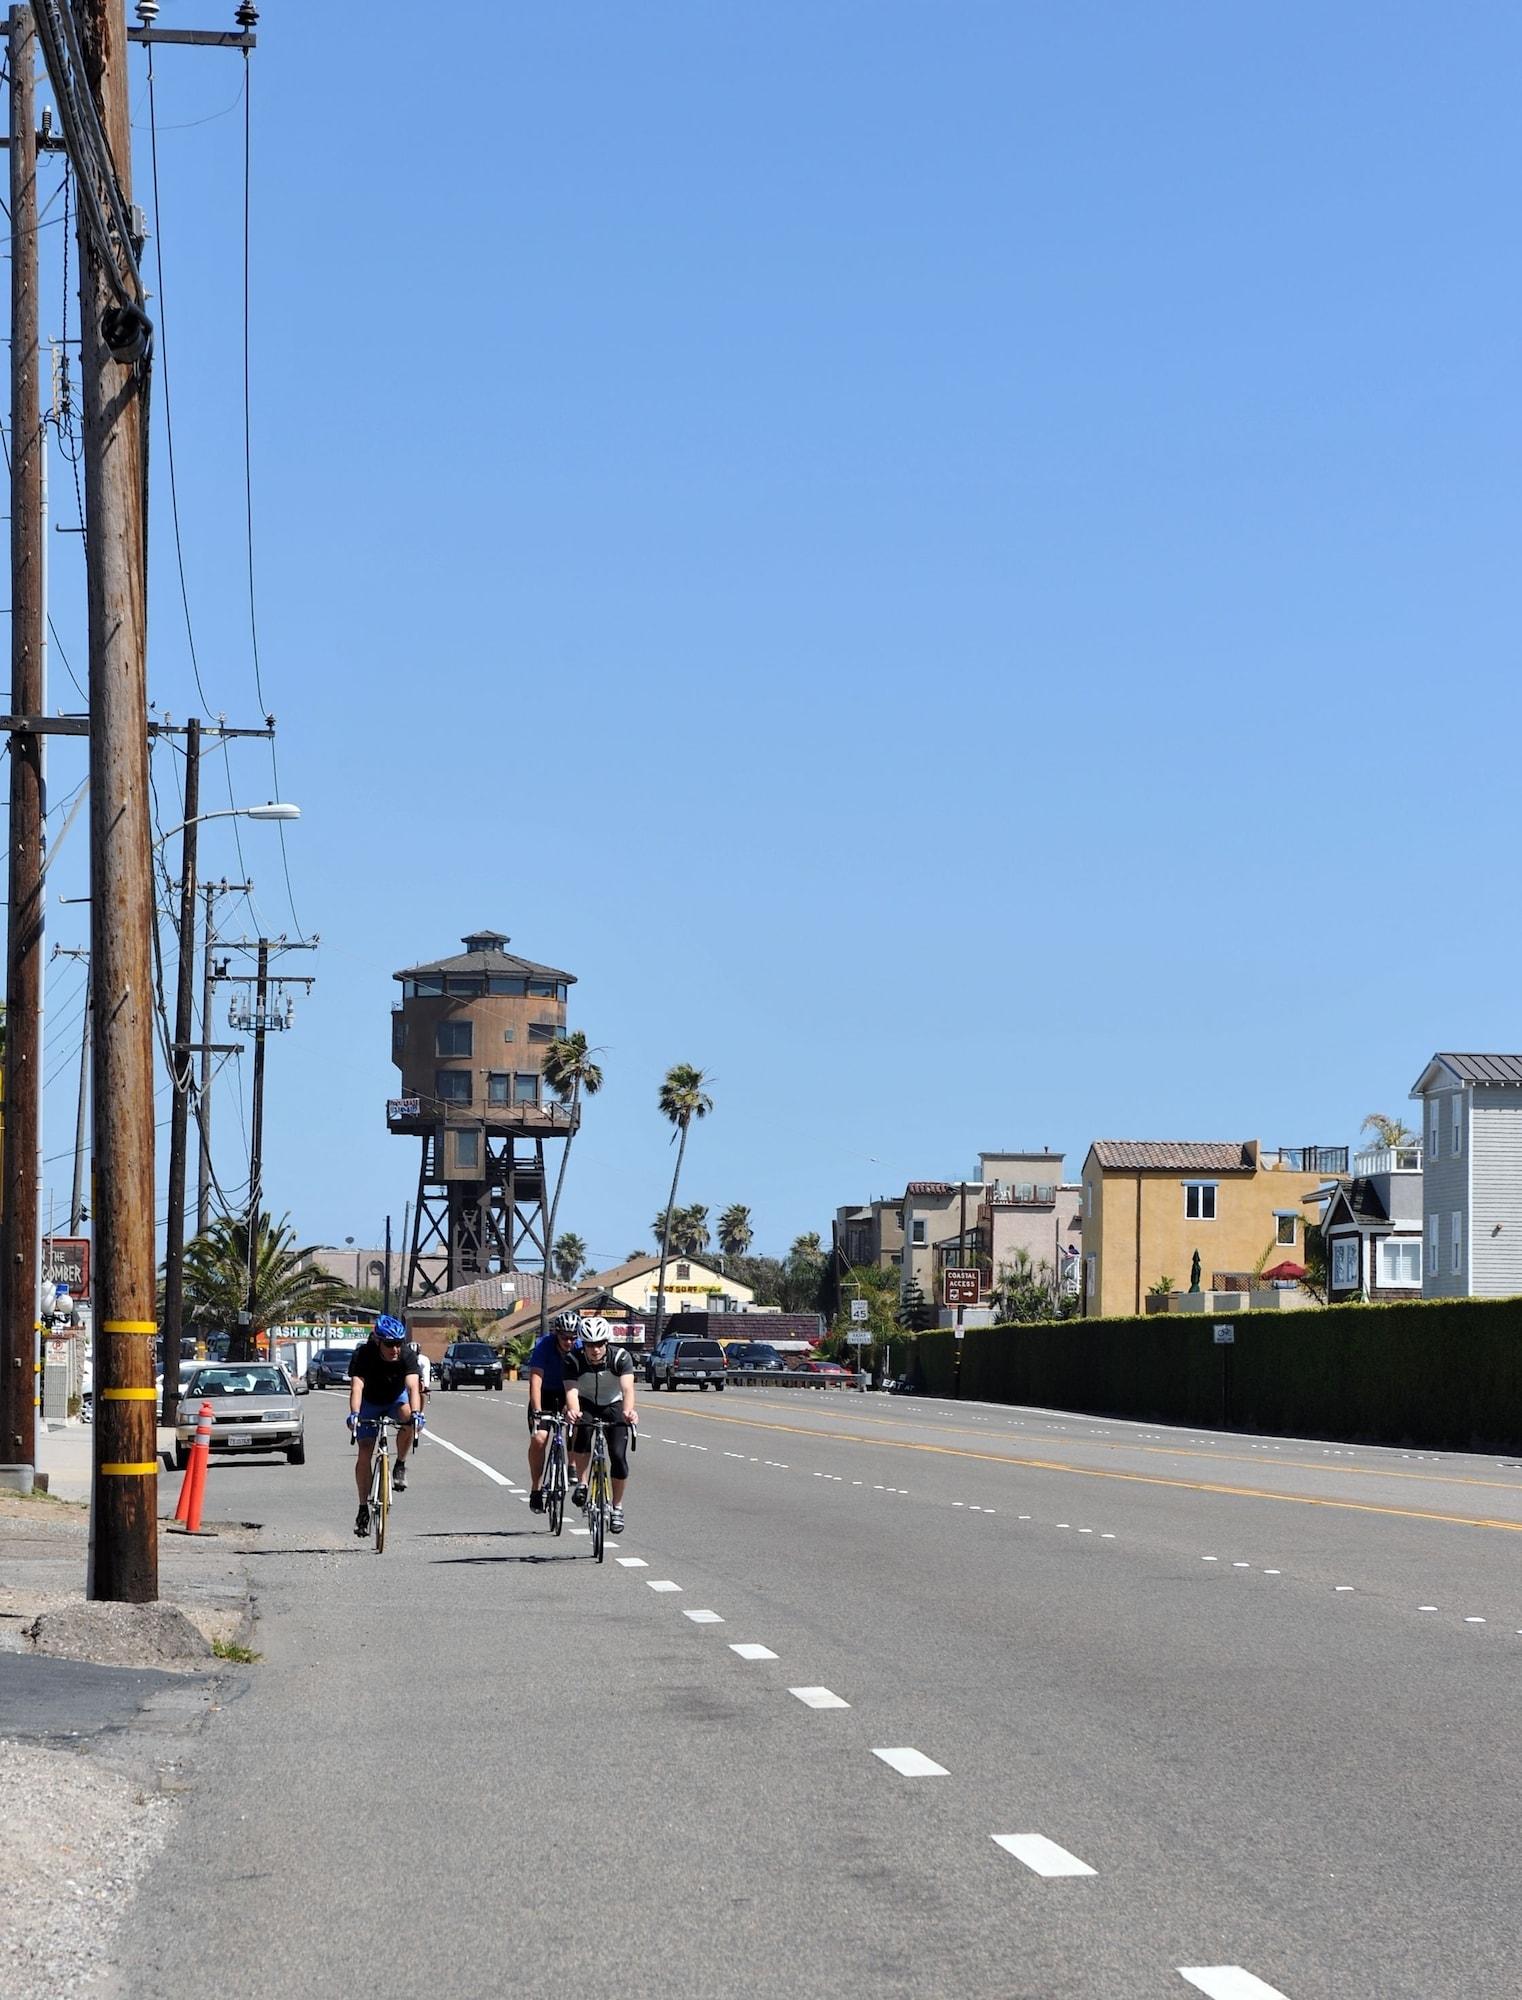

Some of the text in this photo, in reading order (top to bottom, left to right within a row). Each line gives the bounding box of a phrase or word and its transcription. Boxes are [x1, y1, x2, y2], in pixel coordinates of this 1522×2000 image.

[48, 1250, 65, 1262] THE
[853, 1310, 867, 1318] 45
[266, 1326, 299, 1338] CASH
[302, 1327, 311, 1338] 4
[312, 1326, 345, 1338] CARS
[882, 1379, 903, 1389] EAT
